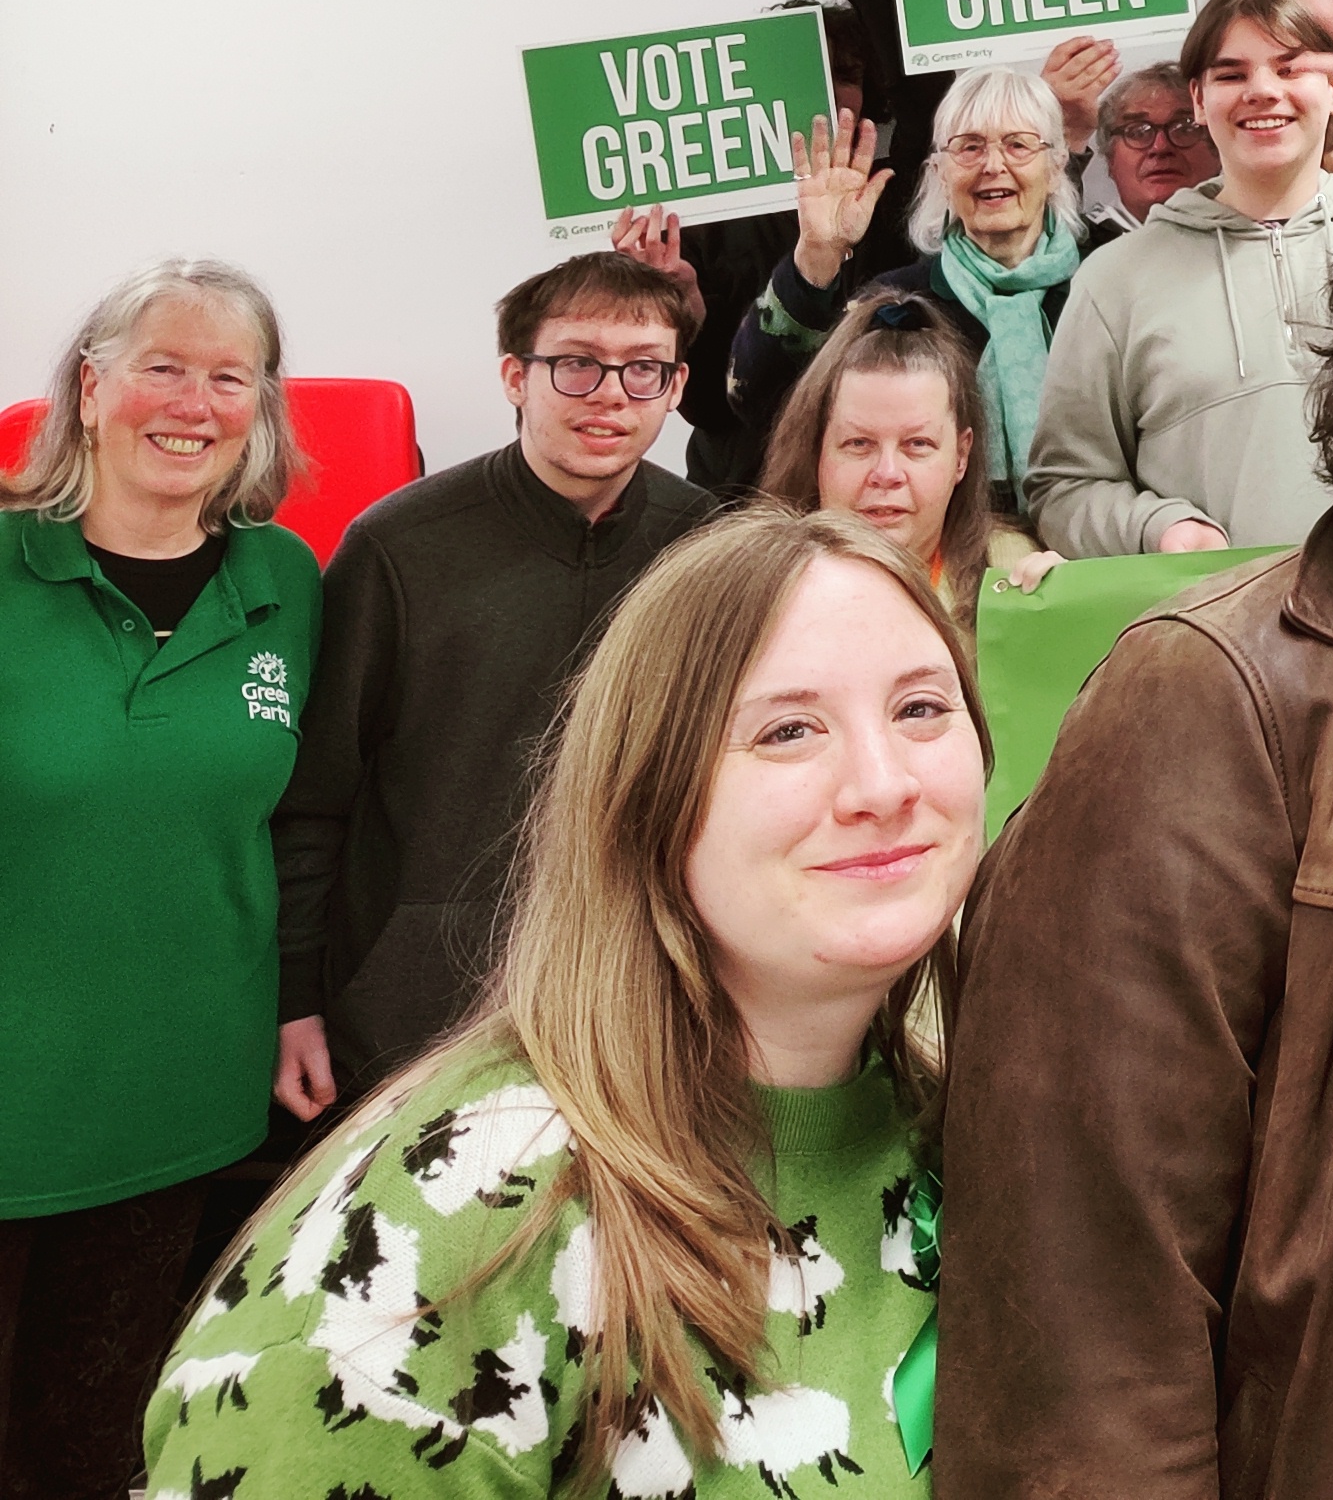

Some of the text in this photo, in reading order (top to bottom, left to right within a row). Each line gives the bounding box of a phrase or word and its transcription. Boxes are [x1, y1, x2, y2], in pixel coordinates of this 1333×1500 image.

[931, 49, 993, 63] Green Party
[600, 33, 754, 117] VOTE
[582, 99, 794, 201] GREEN
[571, 222, 605, 235] Green
[241, 682, 289, 705] Green
[248, 701, 291, 728] Party
